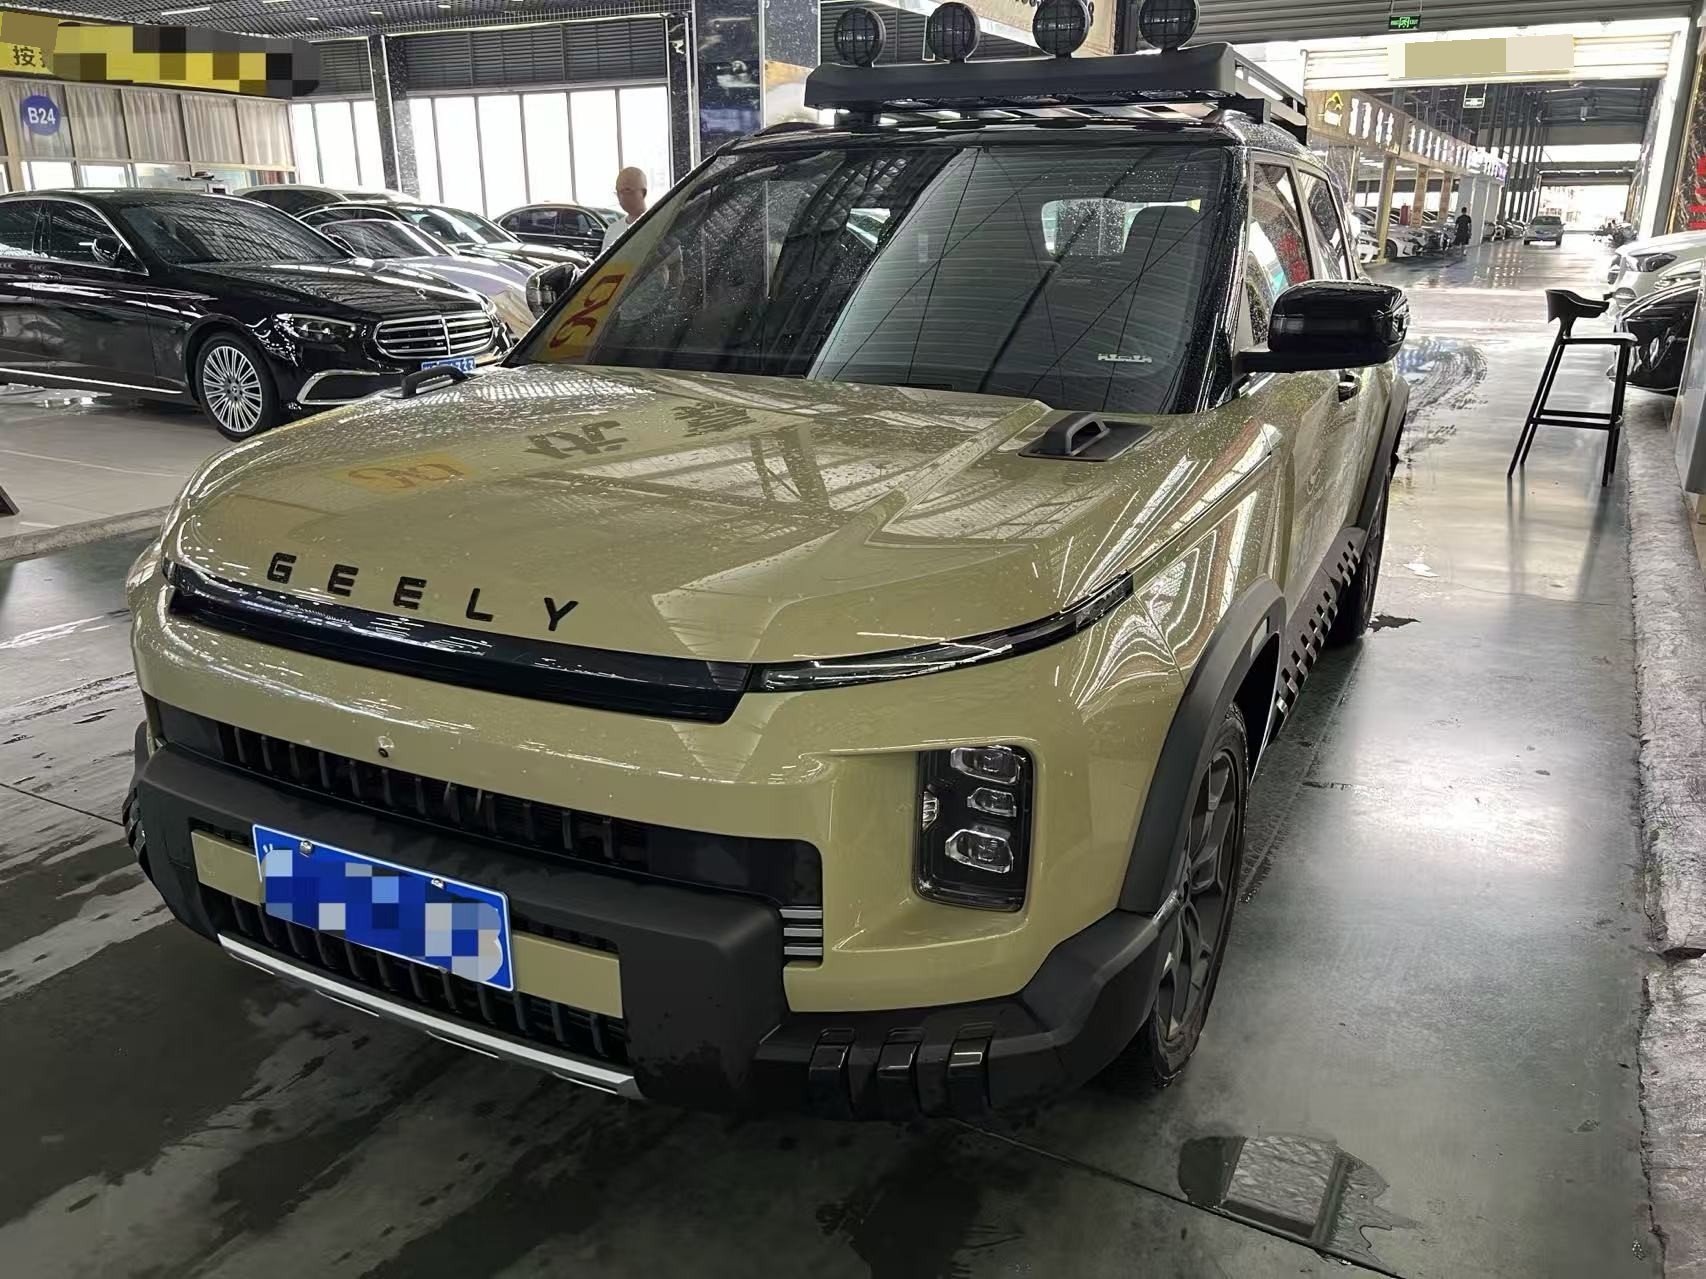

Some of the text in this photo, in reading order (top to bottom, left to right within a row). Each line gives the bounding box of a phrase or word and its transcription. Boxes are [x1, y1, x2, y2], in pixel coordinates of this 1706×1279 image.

[13, 45, 46, 68] 按
[28, 106, 56, 125] B24
[266, 551, 579, 632] GEELY
